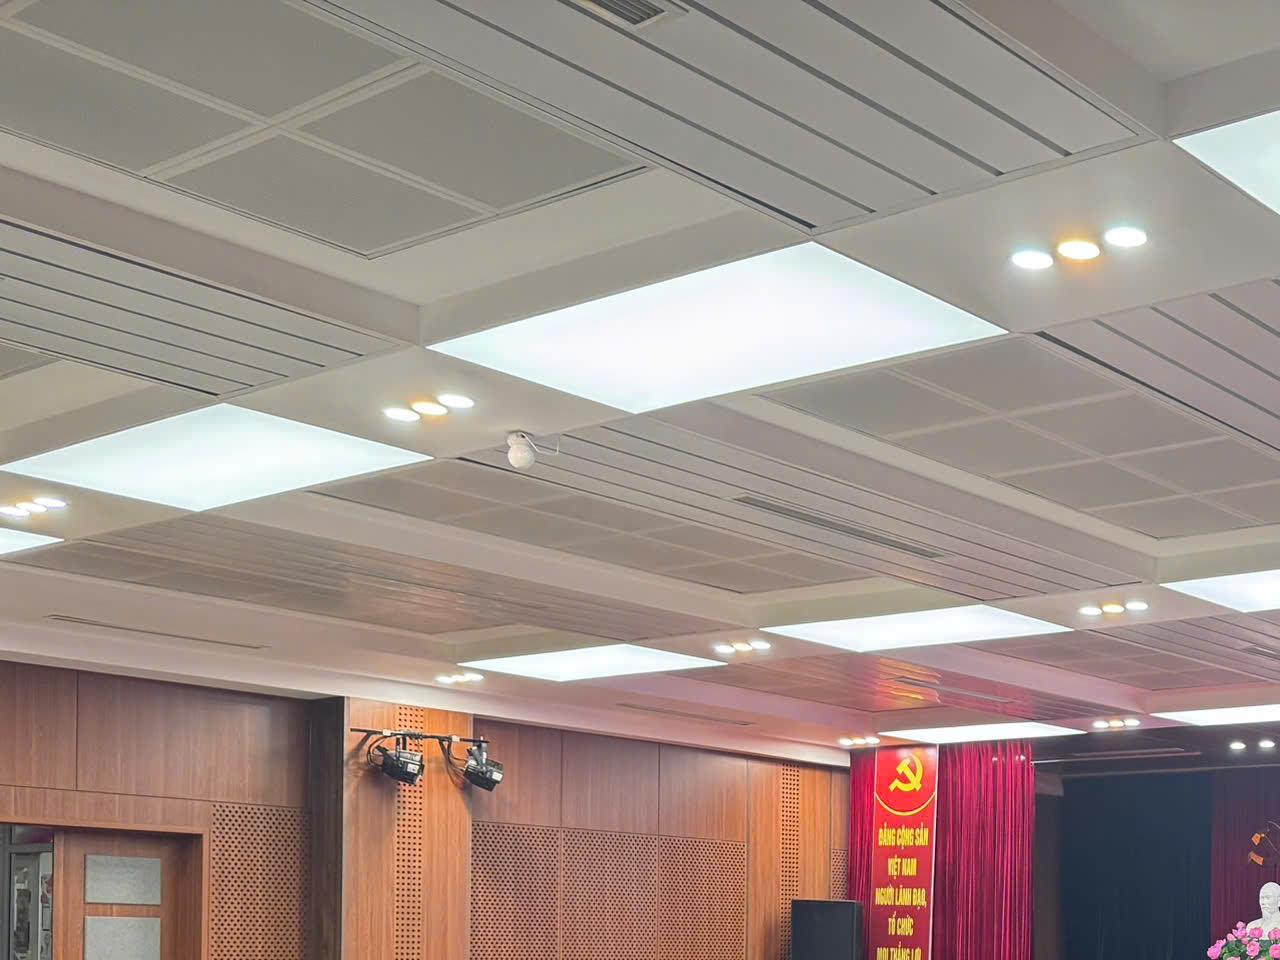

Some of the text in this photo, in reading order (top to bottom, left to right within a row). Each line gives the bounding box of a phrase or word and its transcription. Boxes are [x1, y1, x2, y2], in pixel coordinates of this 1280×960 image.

[878, 822, 929, 850] ĐẢNG CỘNG SẢN
[888, 854, 917, 880] VIỆT NAM
[875, 883, 895, 905] NGƯỜI
[895, 884, 912, 906] LÃNH
[888, 911, 914, 936] TỔ CHỨC
